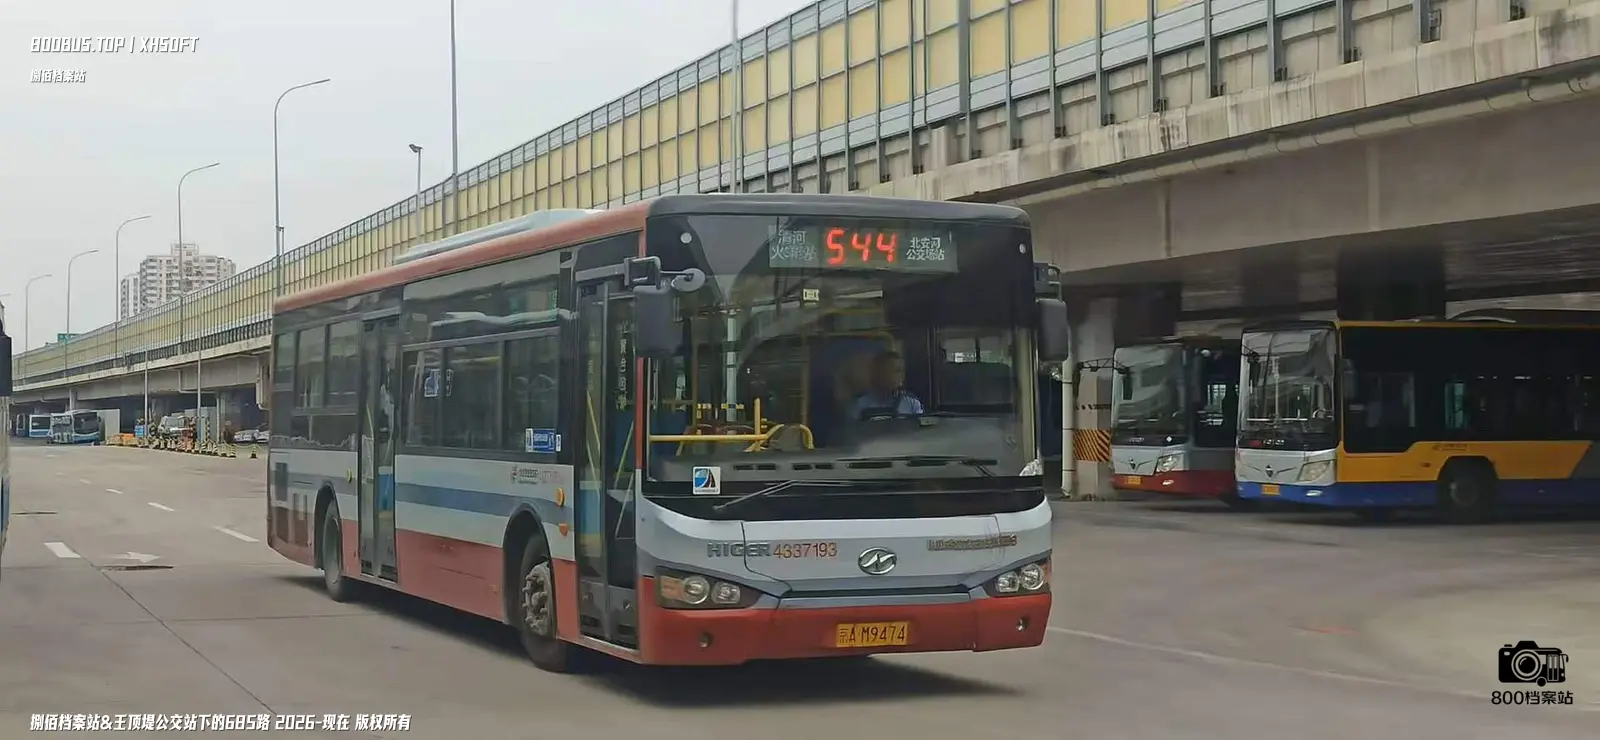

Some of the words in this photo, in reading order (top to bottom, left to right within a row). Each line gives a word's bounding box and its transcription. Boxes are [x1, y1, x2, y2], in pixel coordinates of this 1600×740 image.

[826, 227, 897, 266] 544
[909, 236, 941, 249] 北安河
[707, 542, 771, 558] HIGER
[773, 542, 838, 559] 4337193
